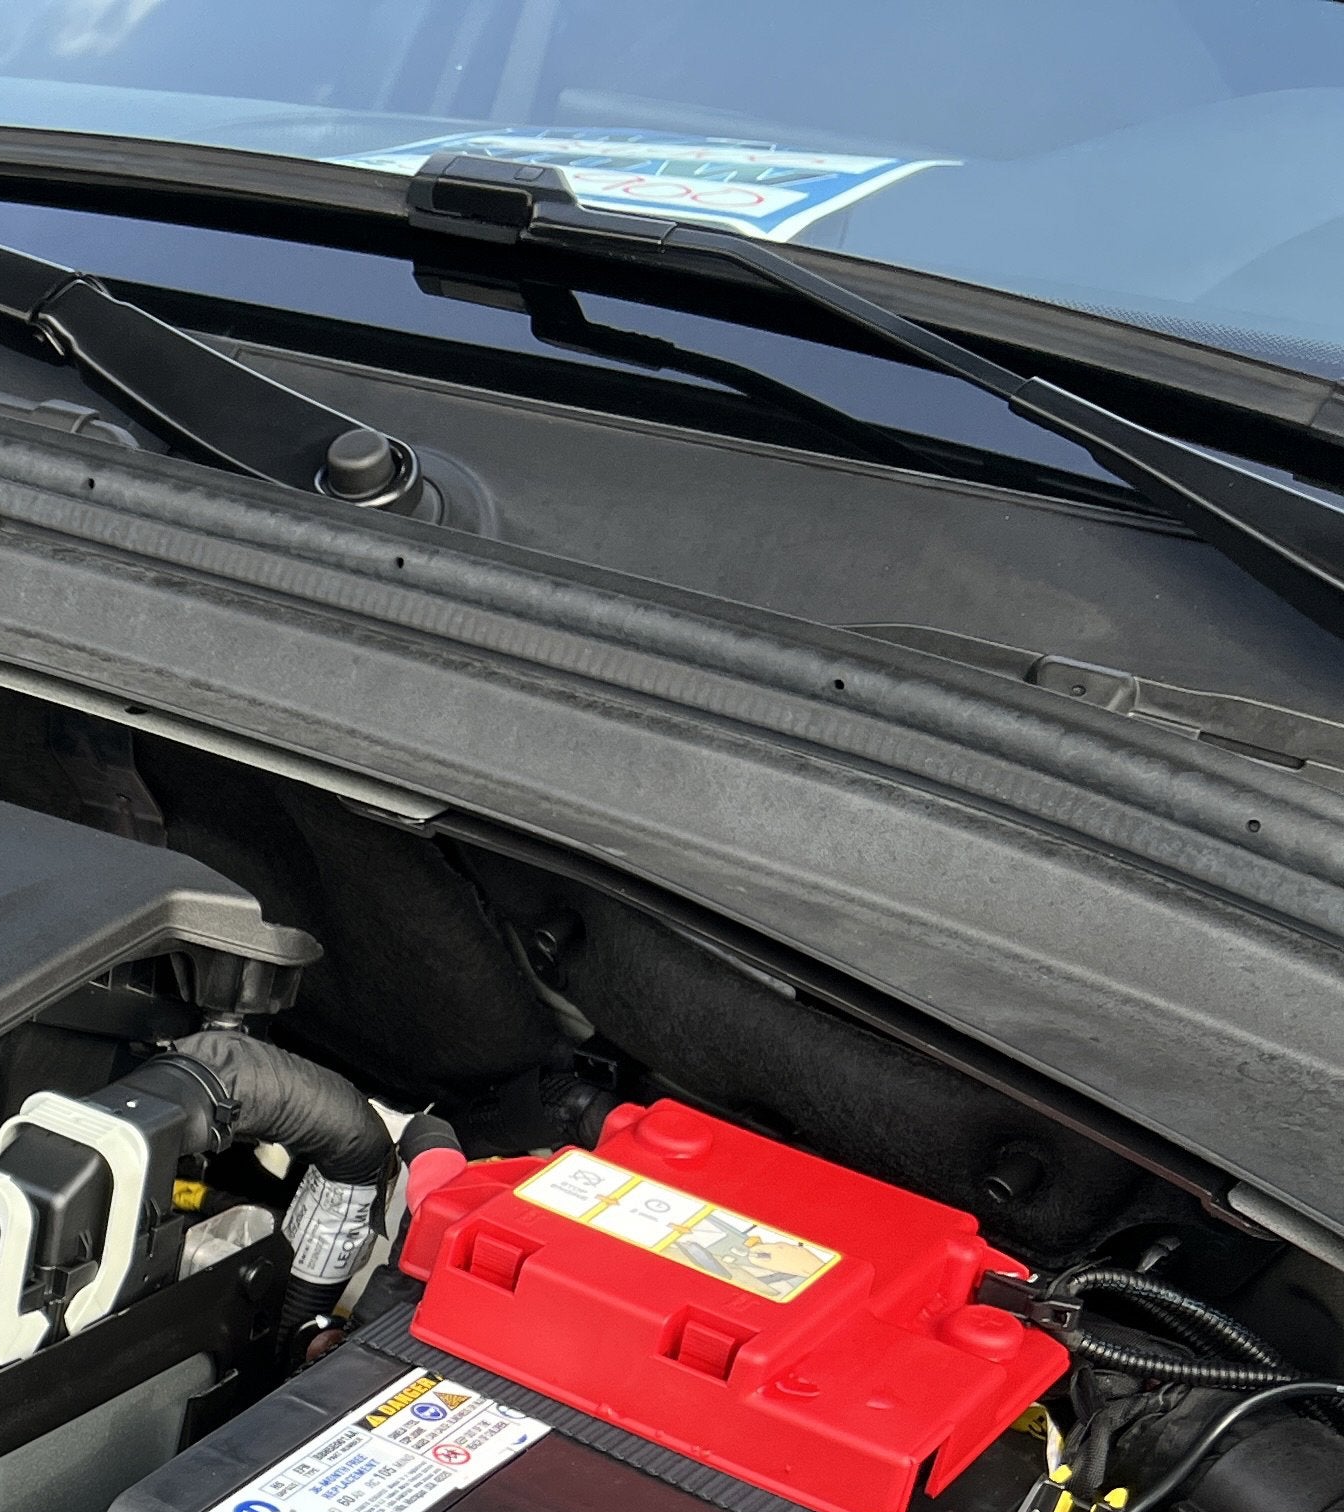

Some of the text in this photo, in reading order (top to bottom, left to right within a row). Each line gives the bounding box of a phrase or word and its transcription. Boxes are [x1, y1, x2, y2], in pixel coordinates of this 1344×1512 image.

[375, 1376, 439, 1416] DANGER
[318, 1457, 383, 1499] REPLACEMENT
[343, 1453, 368, 1468] FREE
[335, 1494, 356, 1506] 60
[371, 1465, 398, 1480] 105
